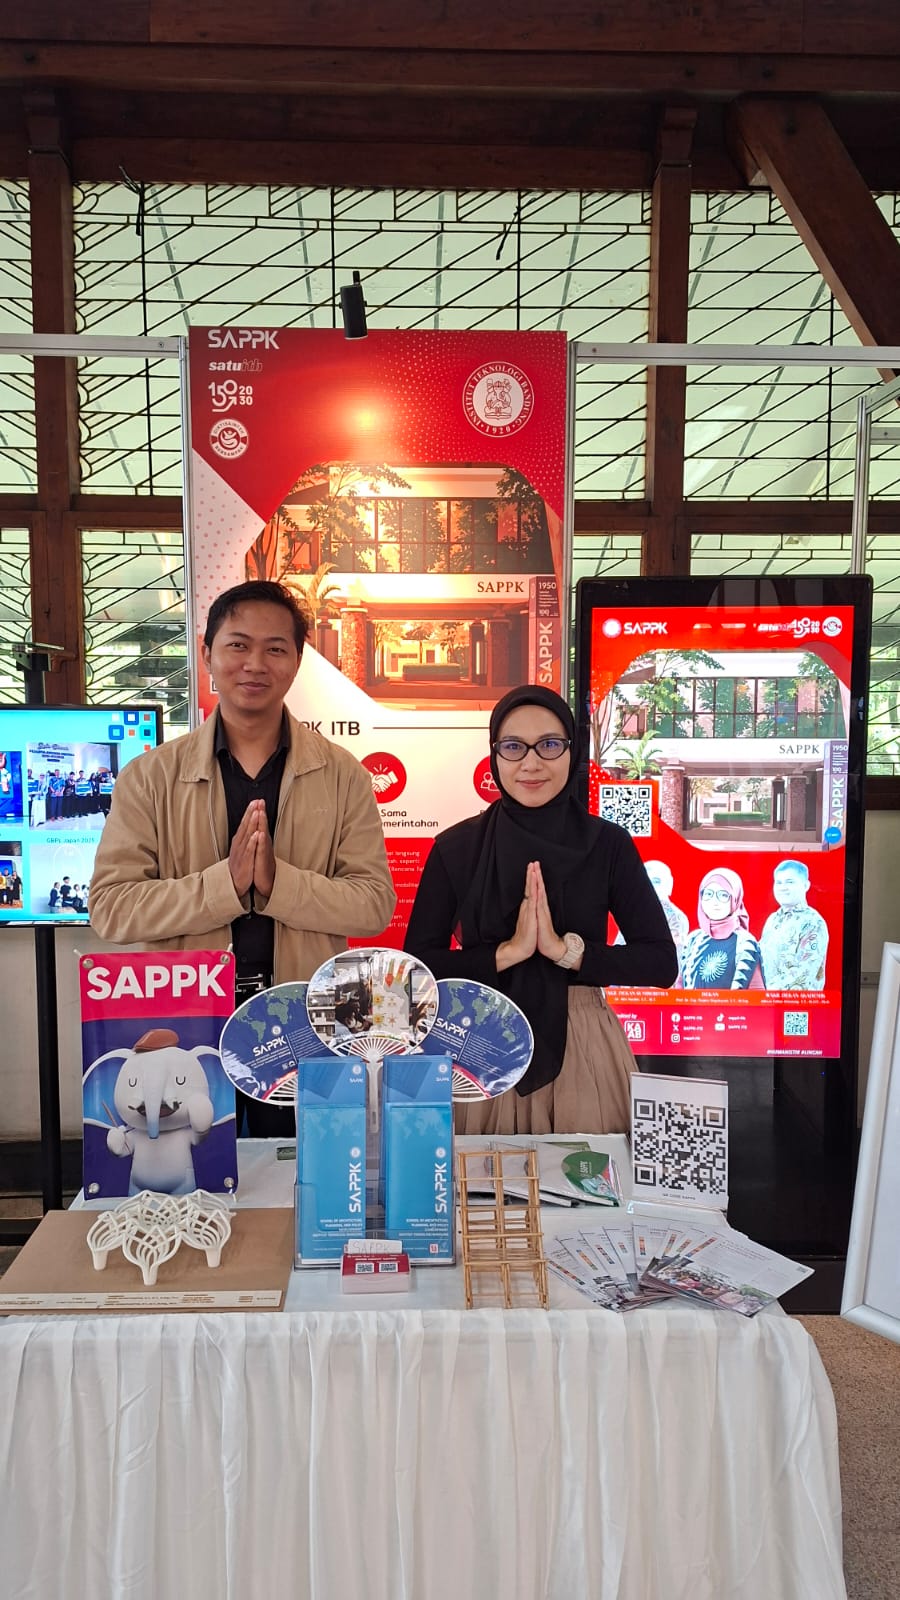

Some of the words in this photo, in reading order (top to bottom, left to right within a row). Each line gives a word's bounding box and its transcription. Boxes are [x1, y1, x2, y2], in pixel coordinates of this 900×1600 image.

[208, 329, 280, 349] SAPPK
[472, 365, 524, 382] TEKNOLOGI
[239, 385, 253, 395] 20
[239, 396, 253, 405] 30
[465, 382, 481, 426] INSTITUT
[515, 380, 532, 426] BANDUNG
[485, 426, 511, 434] 1920
[477, 581, 525, 593] SAPPK
[538, 582, 557, 590] 1950
[623, 621, 668, 635] SAPPK
[538, 621, 553, 684] SAPPK
[331, 721, 360, 736] ITB
[779, 744, 820, 755] SAPPK
[831, 777, 845, 829] SAPPK
[380, 808, 407, 817] Sama
[382, 819, 439, 828] merintahan
[87, 963, 226, 1001] SAPPK
[434, 1017, 468, 1039] SAPPK
[252, 1035, 287, 1057] SAPPK
[349, 1162, 361, 1213] SAPPK
[434, 1162, 448, 1214] SAPPK
